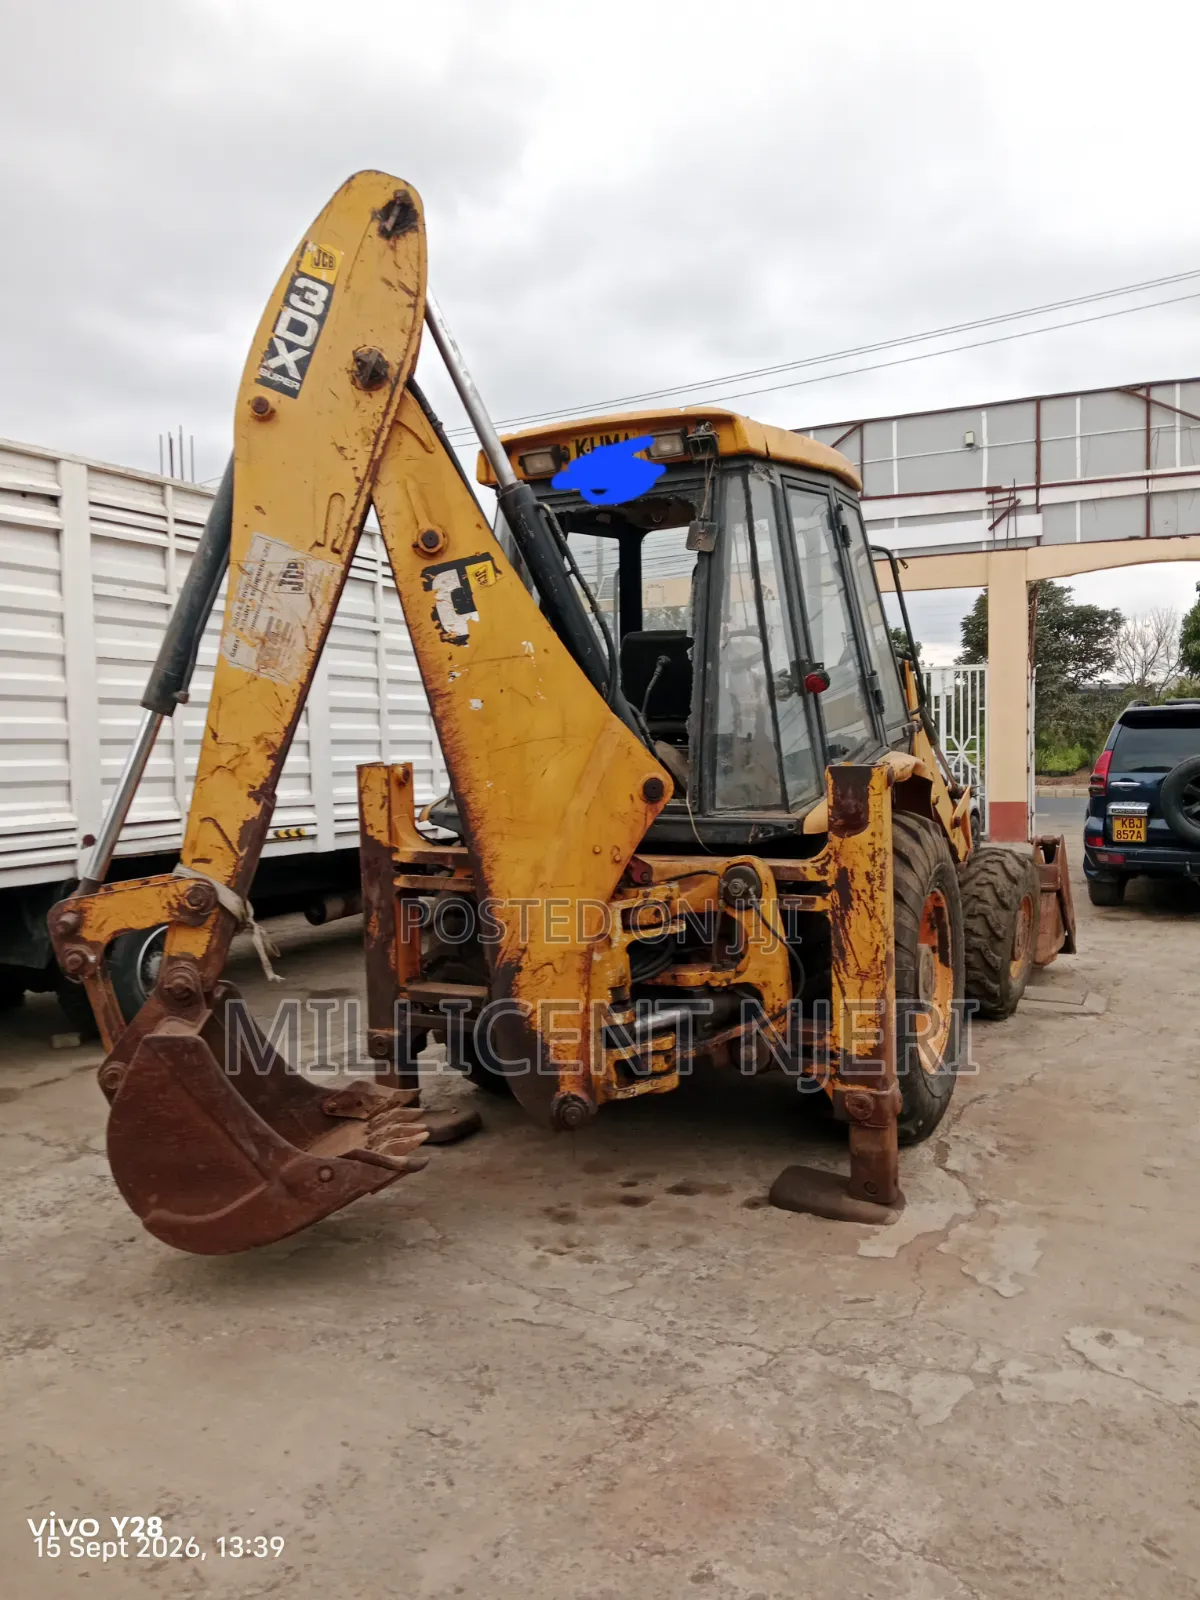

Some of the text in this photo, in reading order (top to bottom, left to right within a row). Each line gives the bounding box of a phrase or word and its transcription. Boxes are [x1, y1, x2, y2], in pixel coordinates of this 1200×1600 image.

[313, 249, 336, 269] JCB
[266, 277, 329, 380] 3DX
[258, 367, 301, 390] SUPER
[1121, 818, 1143, 829] KBJ
[1116, 830, 1142, 840] 857A
